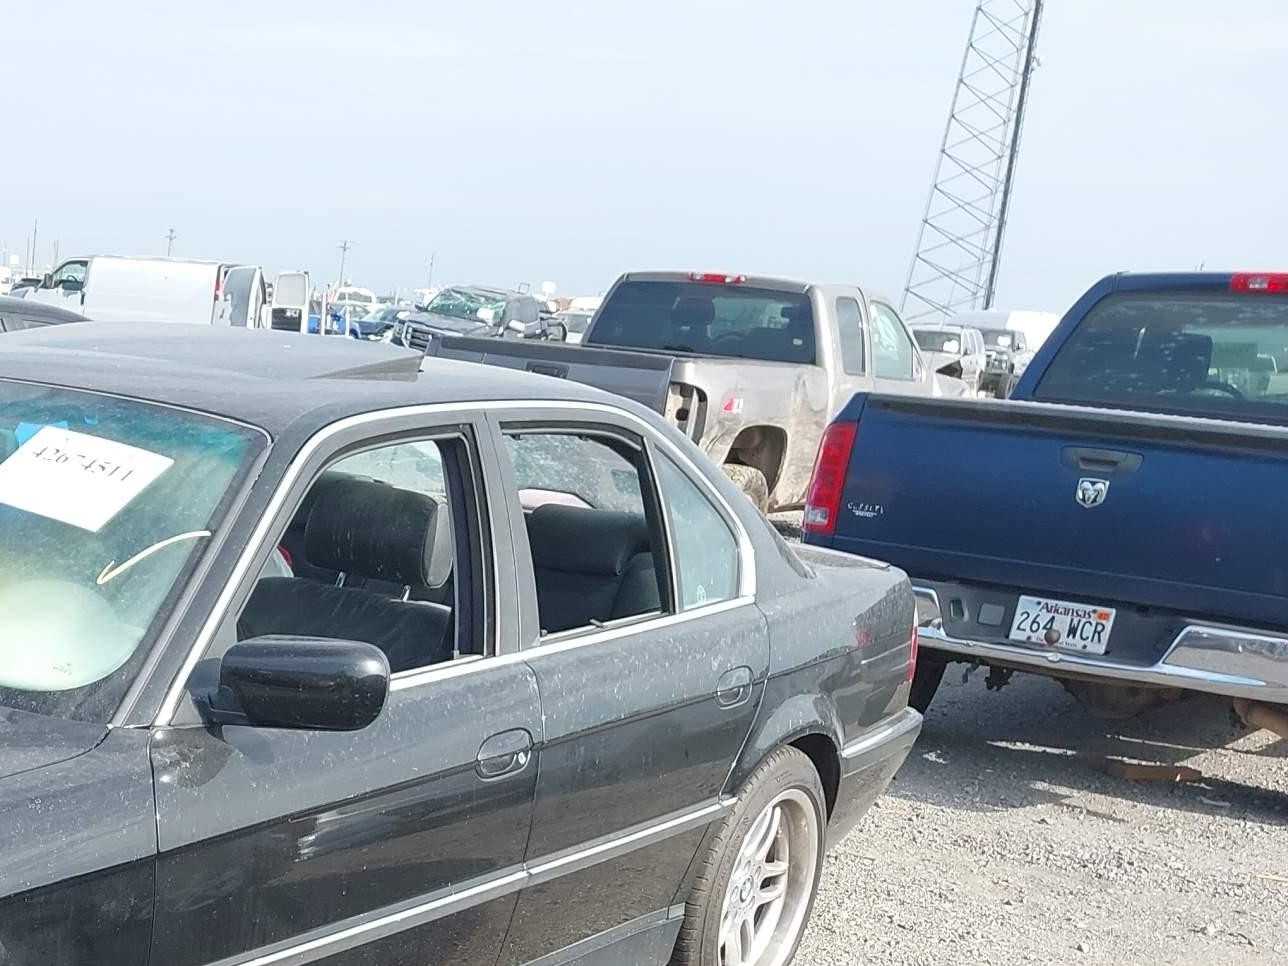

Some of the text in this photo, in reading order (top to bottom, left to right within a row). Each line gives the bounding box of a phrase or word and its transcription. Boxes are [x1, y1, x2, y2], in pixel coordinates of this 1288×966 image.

[1039, 602, 1092, 619] Arkansas
[1016, 611, 1105, 644] 264 WCR
